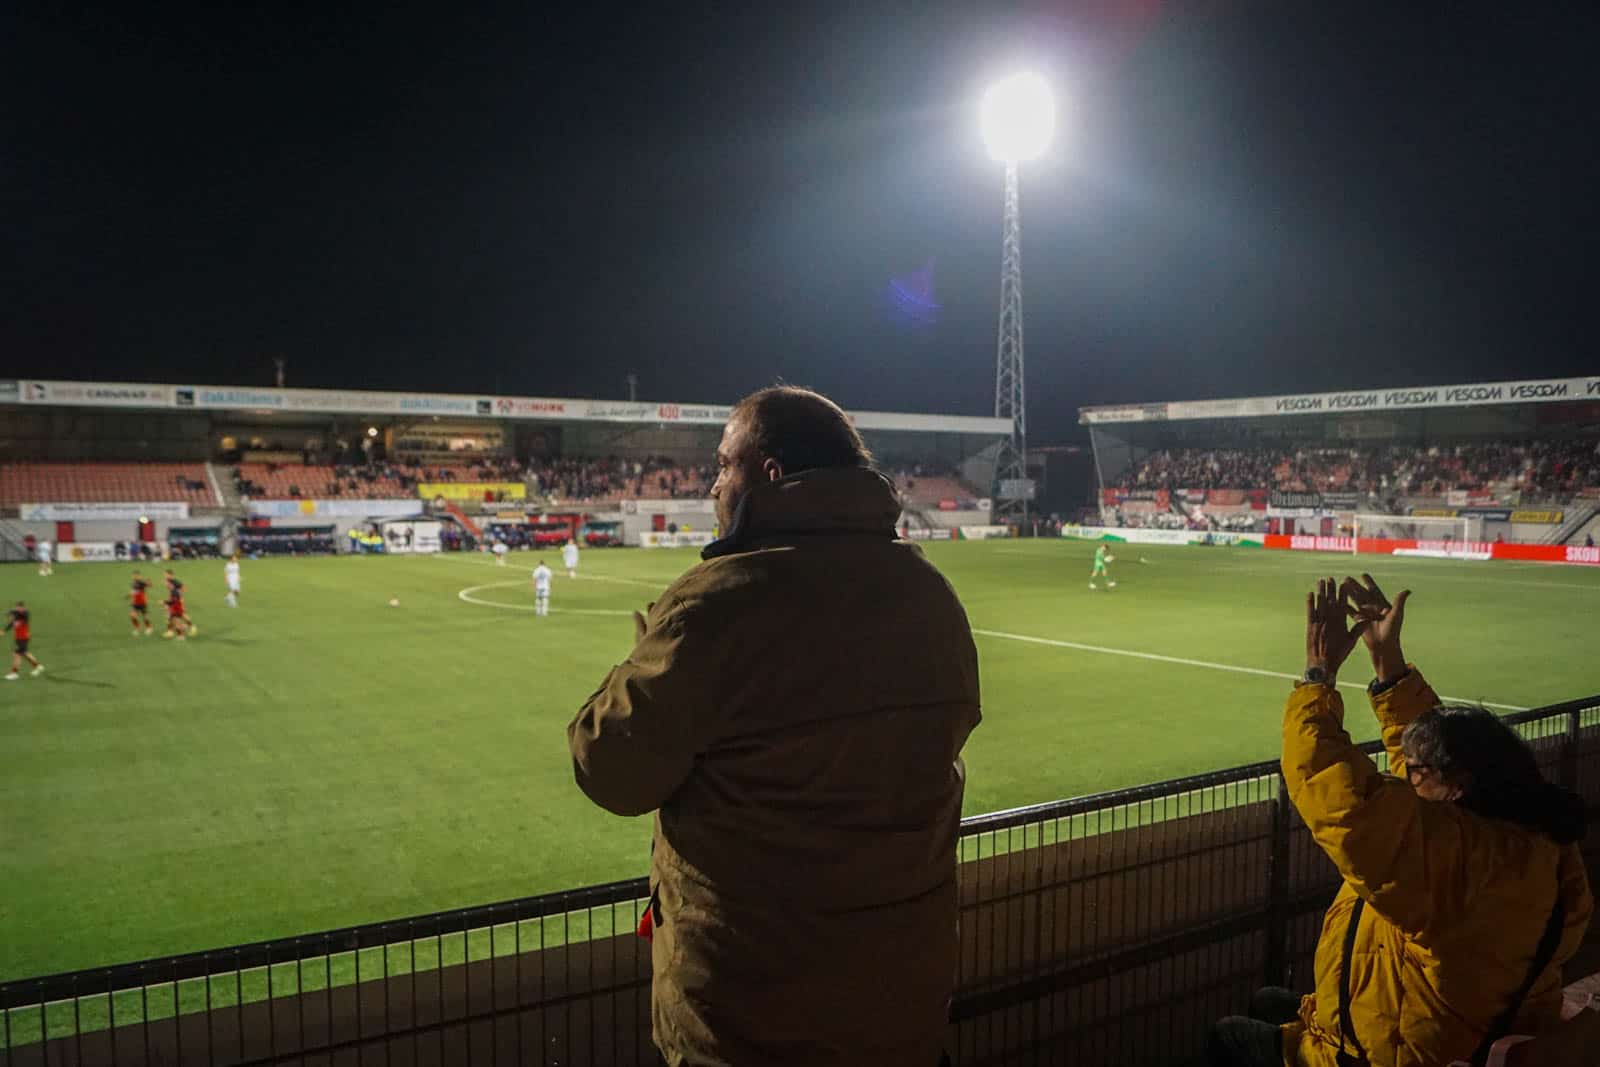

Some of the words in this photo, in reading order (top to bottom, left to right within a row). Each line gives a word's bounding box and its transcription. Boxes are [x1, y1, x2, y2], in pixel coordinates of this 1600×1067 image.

[1276, 398, 1322, 411] VESCOM
[1328, 394, 1377, 408] VESCOM
[1385, 391, 1438, 405] VESCOM
[1446, 387, 1502, 401] VESCOM
[1510, 384, 1568, 398] VESCOM
[1566, 546, 1600, 562] SKON
